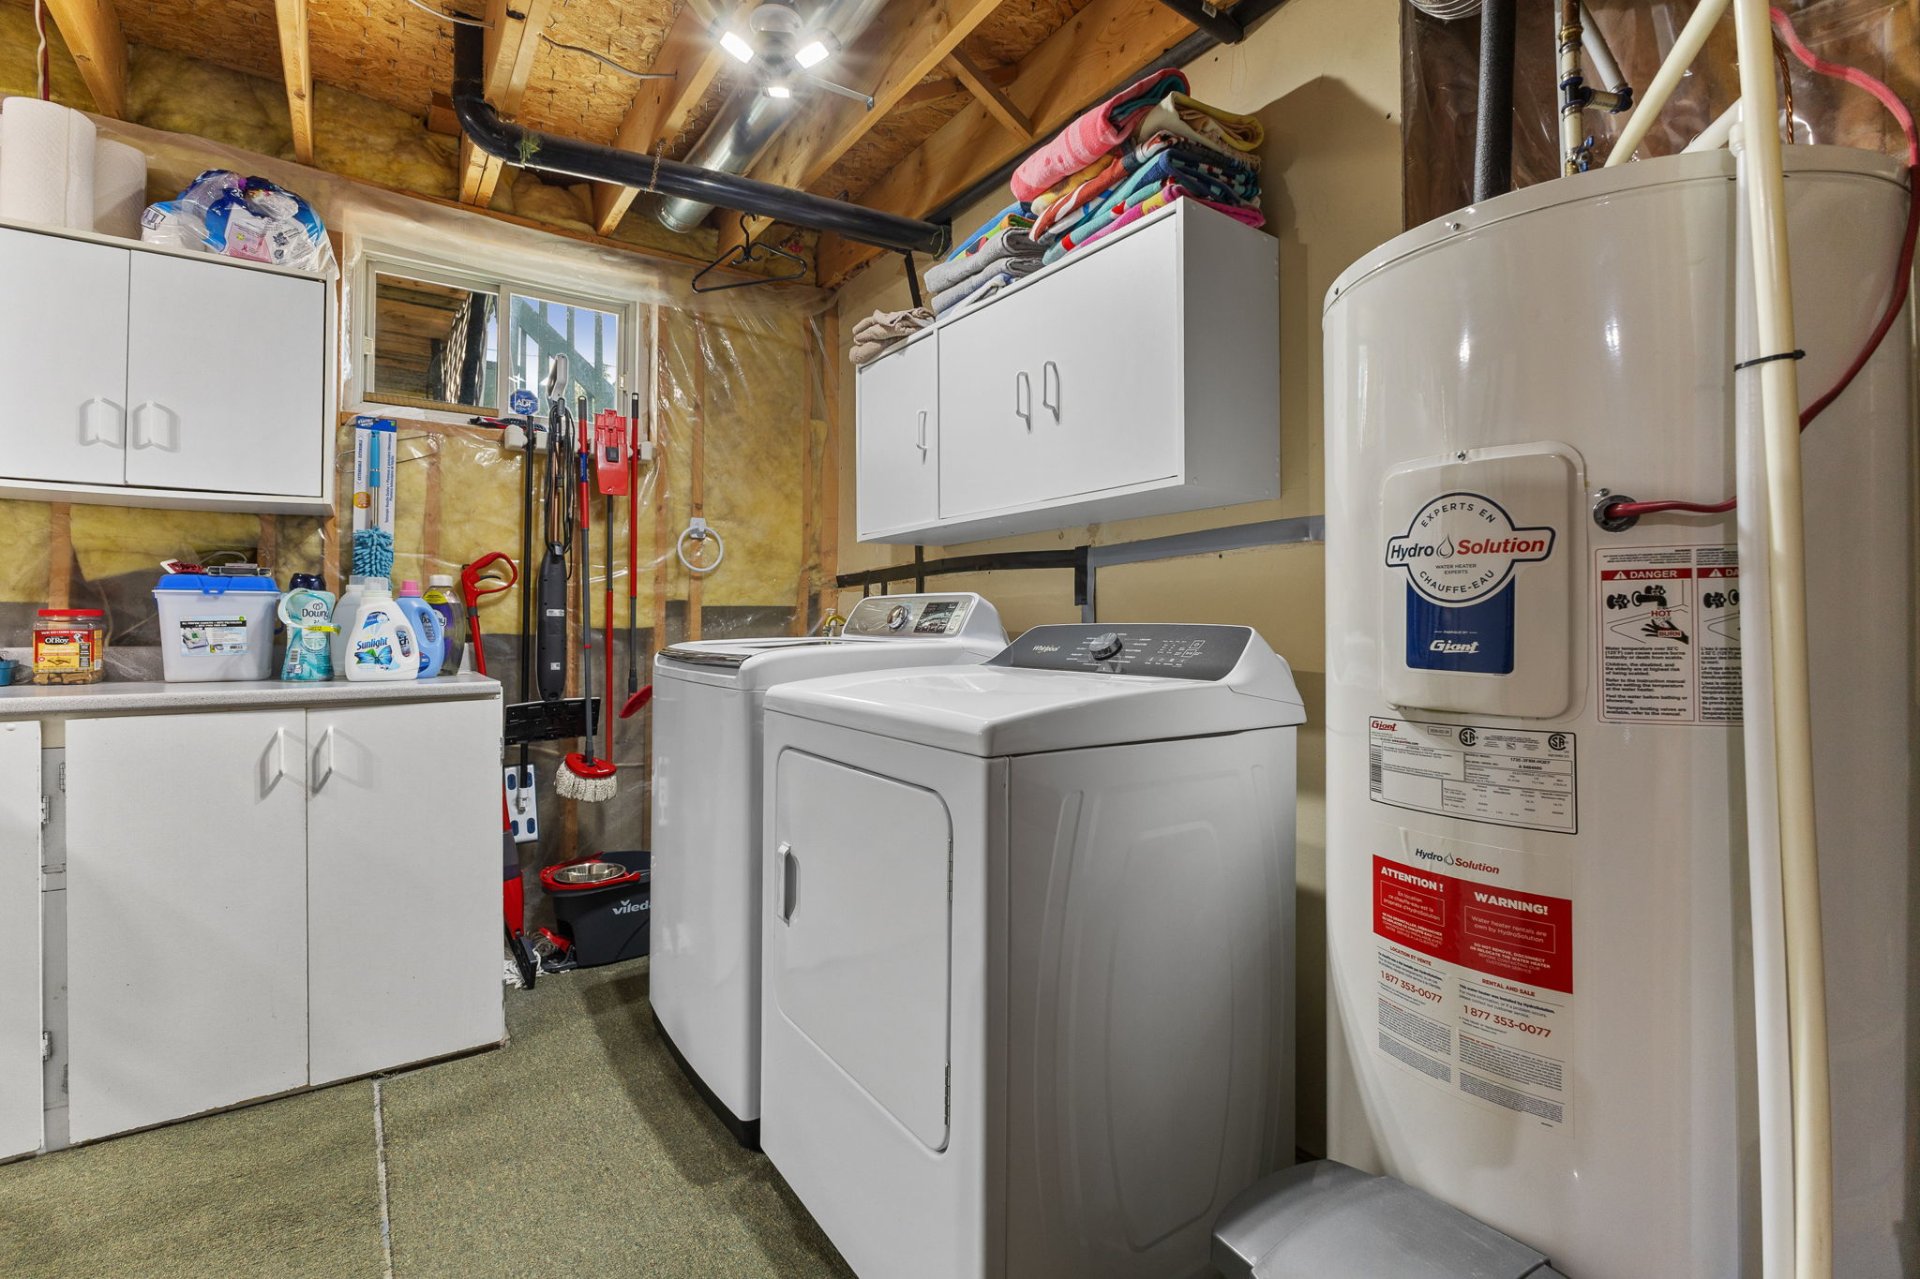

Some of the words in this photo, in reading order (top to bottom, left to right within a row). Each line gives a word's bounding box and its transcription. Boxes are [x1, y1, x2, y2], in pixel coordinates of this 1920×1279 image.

[1421, 502, 1474, 528] EXPERTS
[1478, 508, 1496, 524] EN
[1391, 543, 1434, 562] Hydro
[1456, 537, 1545, 555] Solution
[1419, 569, 1494, 594] CHAUFFE-EAU
[1630, 570, 1678, 579] DANGER
[301, 608, 329, 620] Downy
[356, 637, 388, 651] Sunlight
[1429, 639, 1480, 654] Giant
[1371, 720, 1398, 732] Giant
[1415, 848, 1443, 862] Hydro
[1455, 857, 1499, 874] Solution
[1381, 866, 1437, 891] ATTENTION
[612, 899, 651, 915] viled
[1473, 891, 1549, 916] WARNING!
[1471, 915, 1490, 924] Water
[1491, 920, 1511, 929] heater
[1512, 926, 1534, 934] rentals
[1390, 946, 1410, 958] LOCATION
[1416, 957, 1432, 966] VENTE
[1386, 972, 1399, 985] 877
[1400, 979, 1442, 1004] 353-0077
[1481, 978, 1504, 989] RENTAL
[1505, 985, 1518, 993] AND
[1519, 988, 1536, 997] SALE
[1463, 1005, 1468, 1014] 1
[1470, 1007, 1490, 1020] 877
[1493, 1014, 1552, 1038] 353-0077
